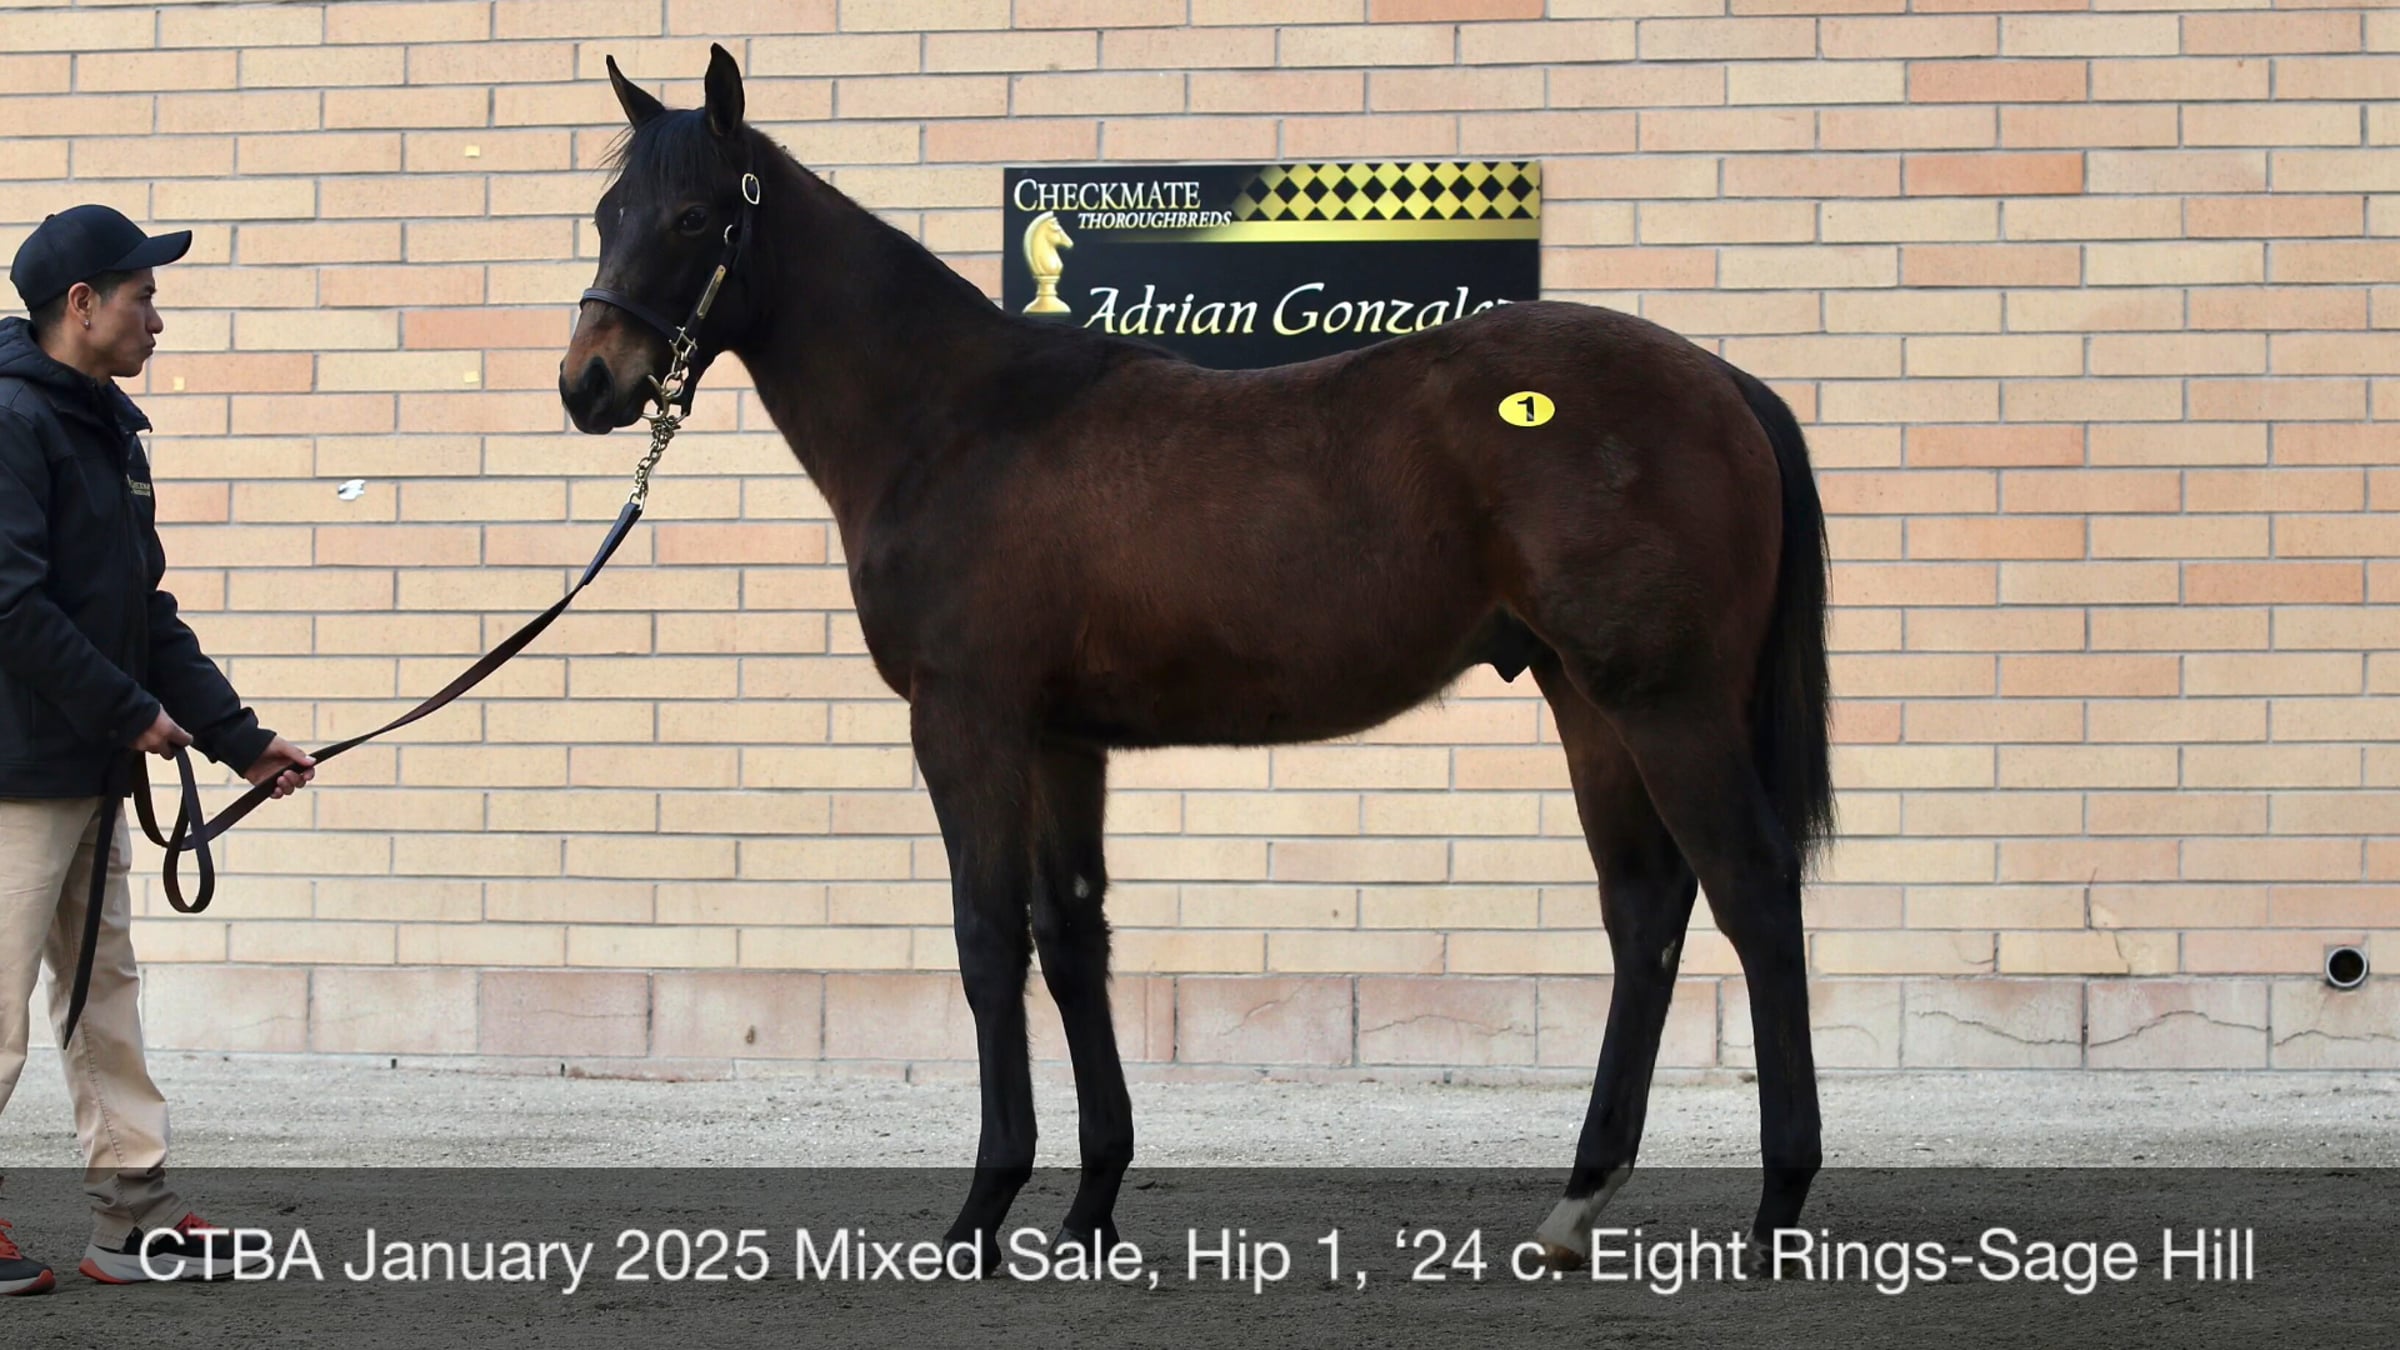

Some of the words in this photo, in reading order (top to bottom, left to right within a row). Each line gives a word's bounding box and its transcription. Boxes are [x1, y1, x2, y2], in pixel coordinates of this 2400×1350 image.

[1013, 178, 1201, 212] CHECKMATE
[1077, 210, 1232, 230] THOROUGHBREDS
[1082, 284, 1258, 335] Adrian
[1272, 282, 1515, 336] Gonzal
[1517, 395, 1535, 422] 1
